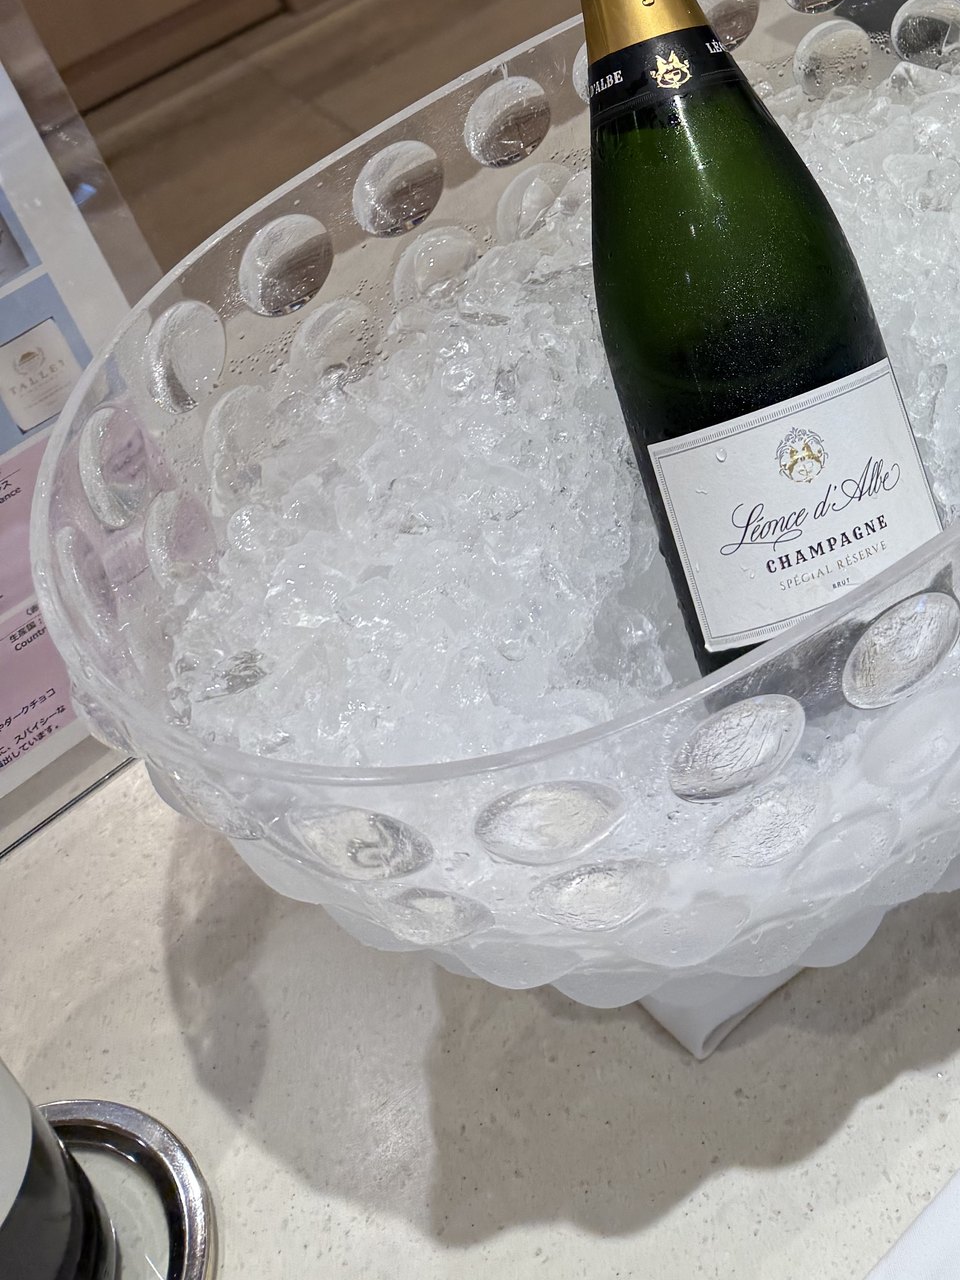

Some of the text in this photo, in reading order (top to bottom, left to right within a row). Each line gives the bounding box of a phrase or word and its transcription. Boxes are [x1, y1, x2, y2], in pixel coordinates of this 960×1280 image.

[720, 503, 808, 556] Léonce
[765, 514, 889, 574] CHAMPAGNE
[779, 540, 888, 591] SPÉCIAL RÉSERVE
